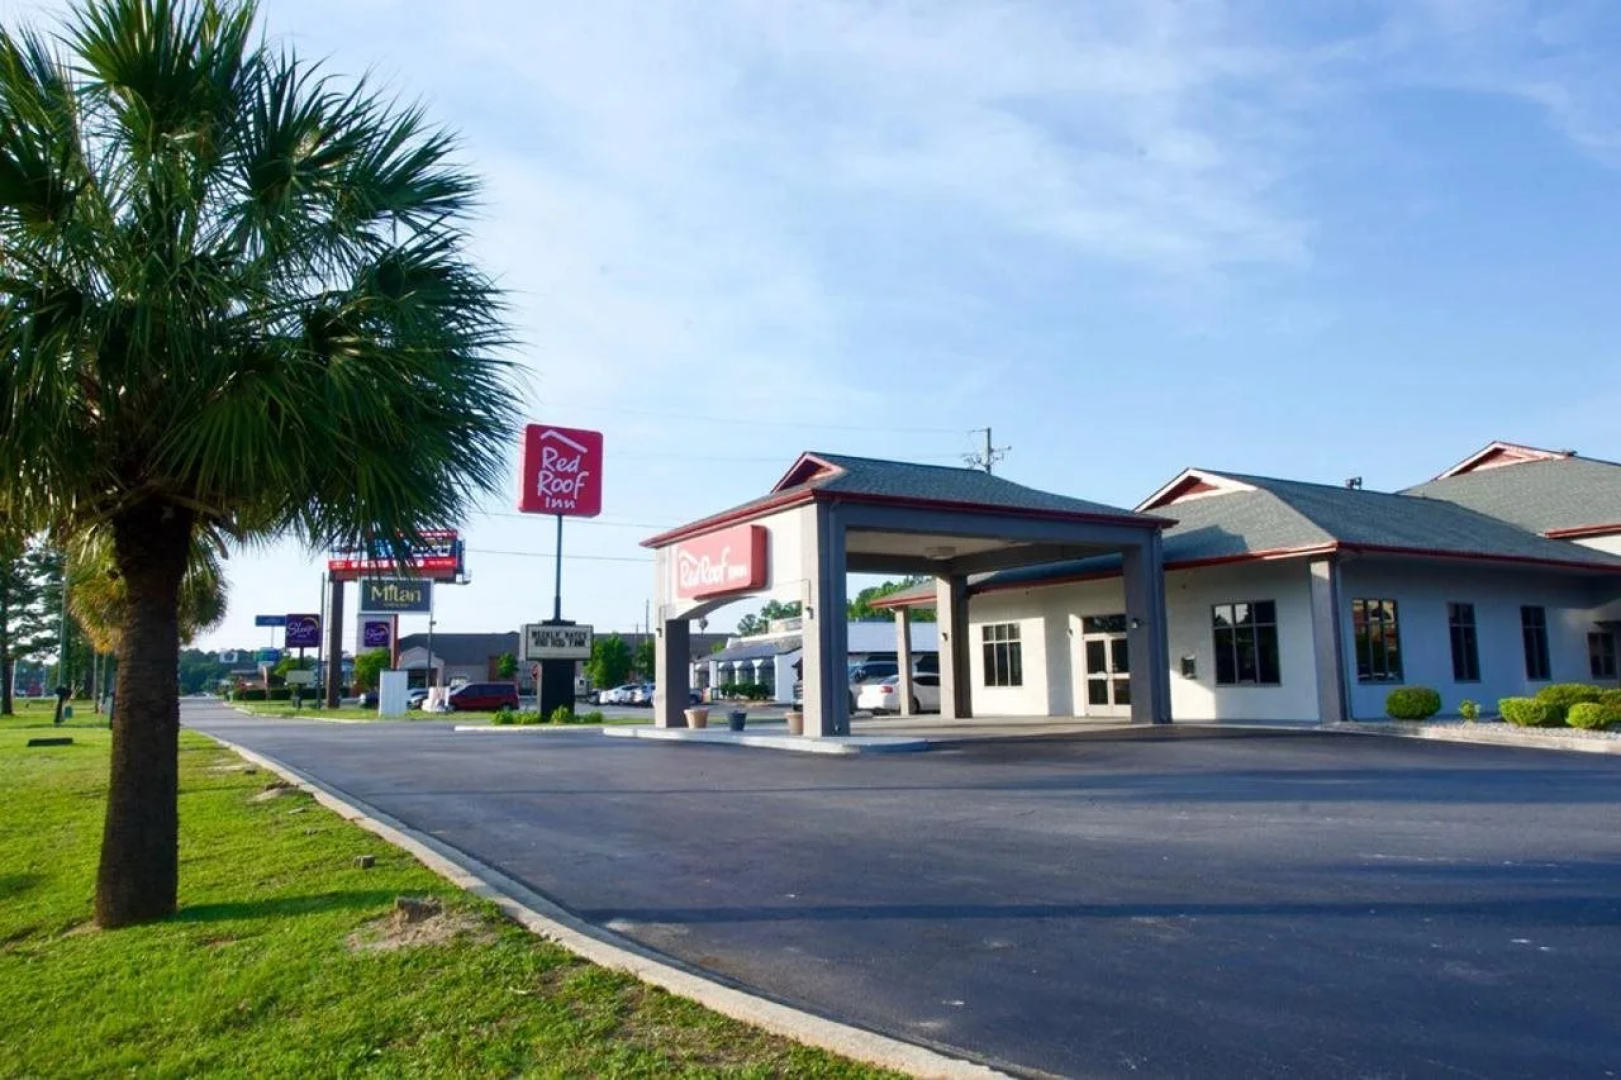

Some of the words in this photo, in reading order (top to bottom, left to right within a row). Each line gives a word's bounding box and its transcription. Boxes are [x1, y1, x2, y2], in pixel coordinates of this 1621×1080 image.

[541, 446, 581, 473] Red
[537, 470, 590, 500] Roof
[700, 546, 731, 586] Roof
[371, 584, 422, 603] Milan
